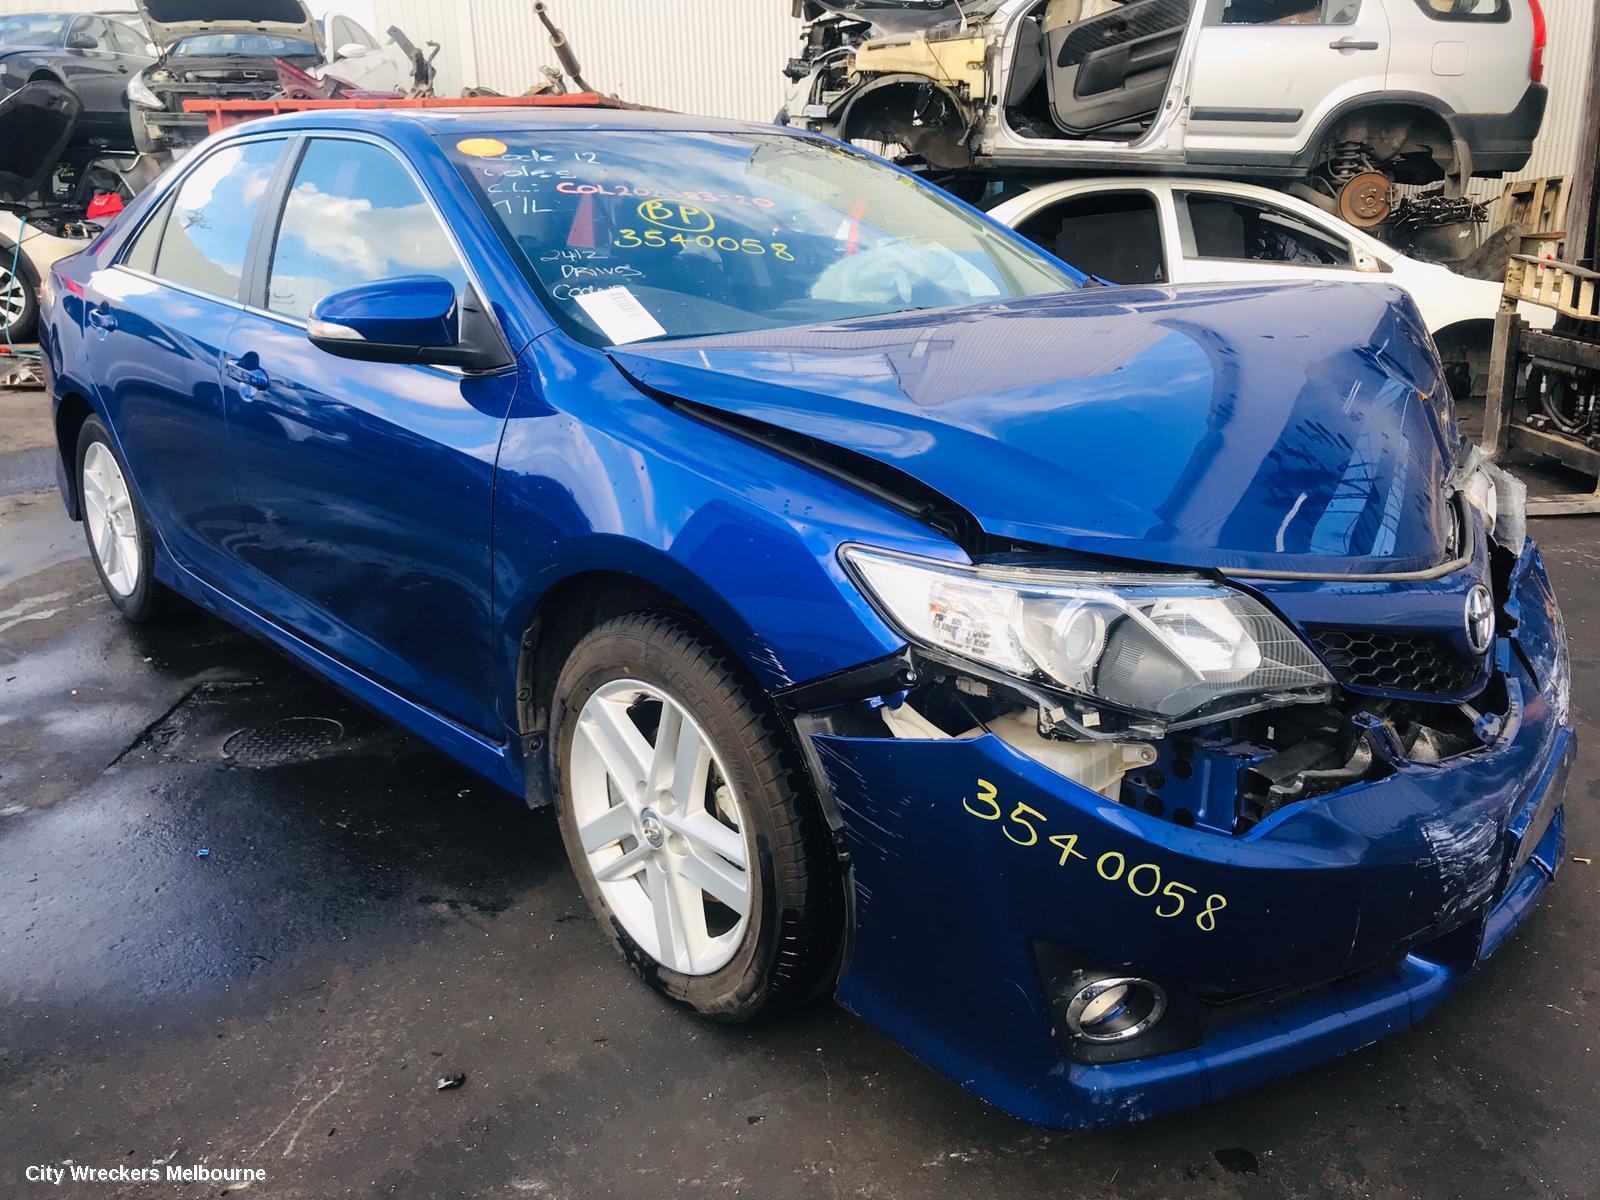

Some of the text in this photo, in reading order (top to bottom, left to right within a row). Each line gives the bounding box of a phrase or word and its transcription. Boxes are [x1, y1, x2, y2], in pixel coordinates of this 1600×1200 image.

[645, 200, 703, 225] BP
[614, 228, 795, 262] 3540058
[963, 778, 1228, 931] 3540058
